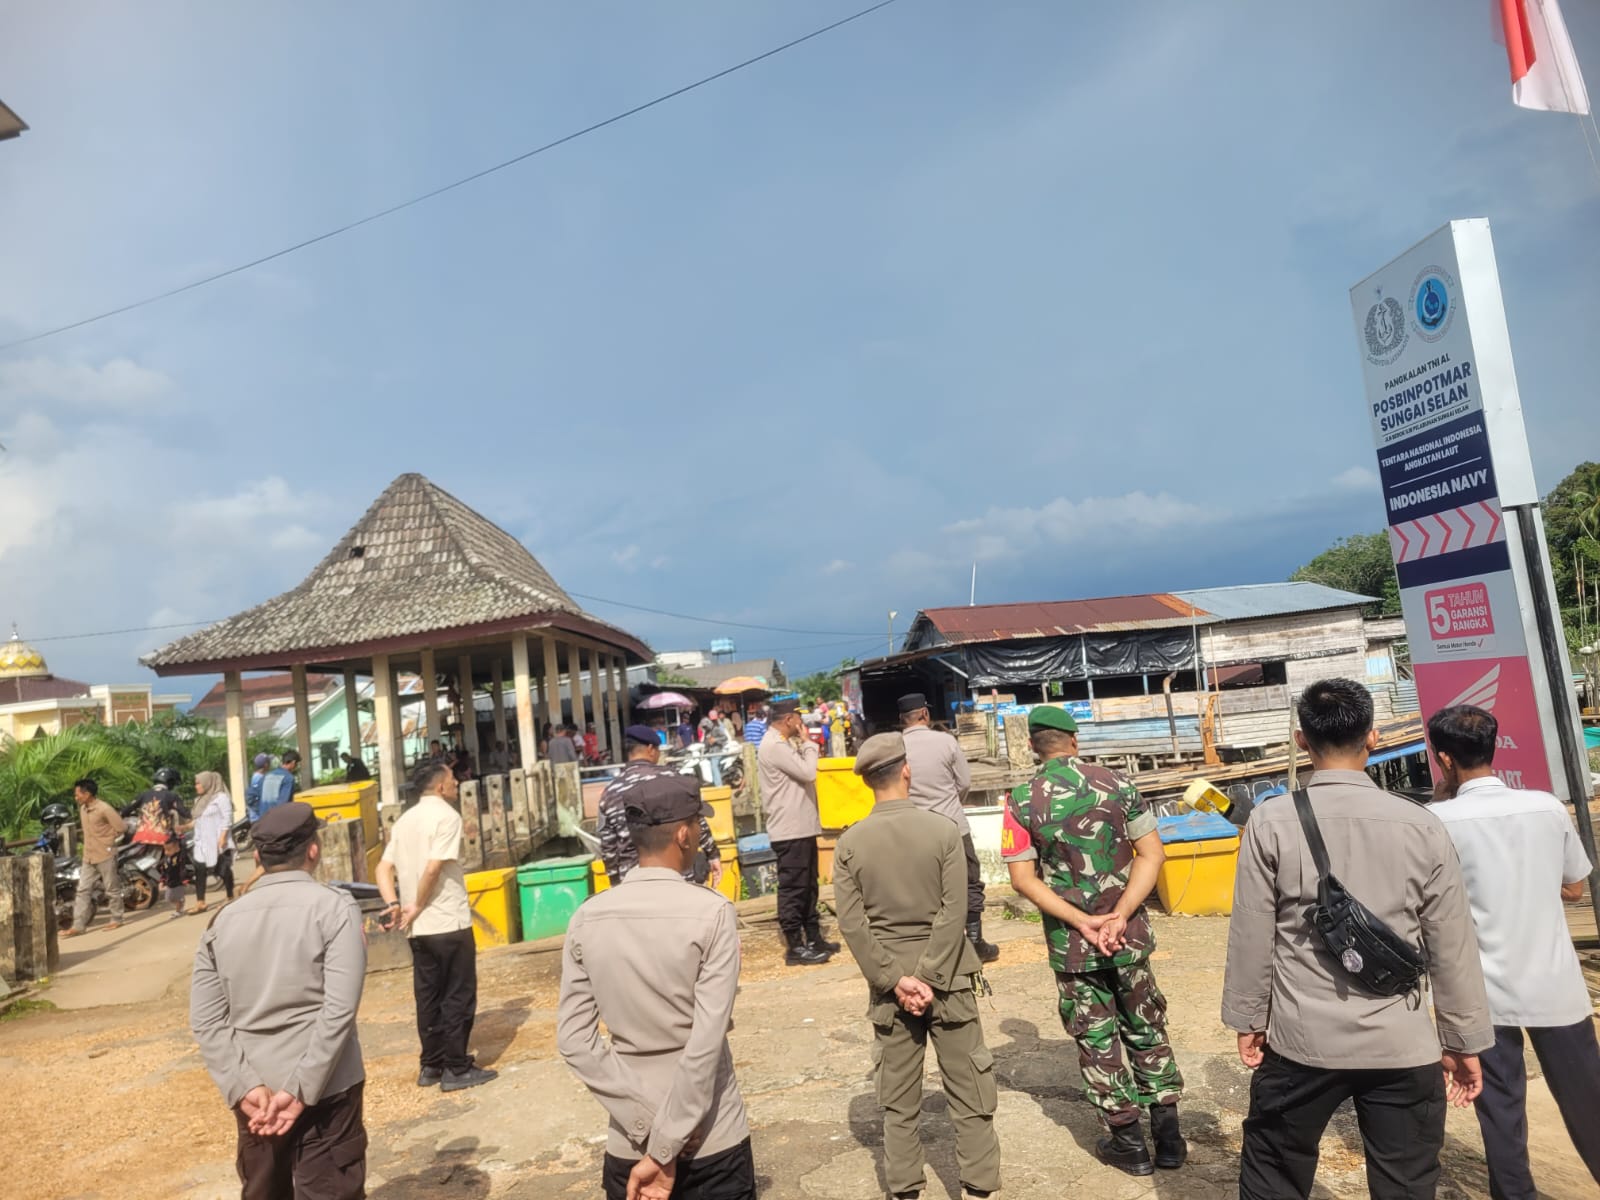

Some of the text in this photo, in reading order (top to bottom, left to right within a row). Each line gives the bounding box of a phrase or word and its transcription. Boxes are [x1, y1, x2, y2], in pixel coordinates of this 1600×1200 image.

[1373, 361, 1471, 417] POSBINPOTMAR
[1384, 353, 1451, 390] PANGKALAN TNI AL
[1380, 382, 1468, 431] SUNGAI SELAN
[1381, 424, 1482, 467] TENTARA NASIONAL INDONESIA
[1404, 445, 1459, 471] ANGKATAN LAUT
[1389, 468, 1487, 511] INDONESIA NAVY
[1430, 595, 1451, 634] 5
[1447, 589, 1484, 608] TAHUN
[1450, 606, 1488, 619] GARANSI
[1452, 618, 1488, 632] RANGKA
